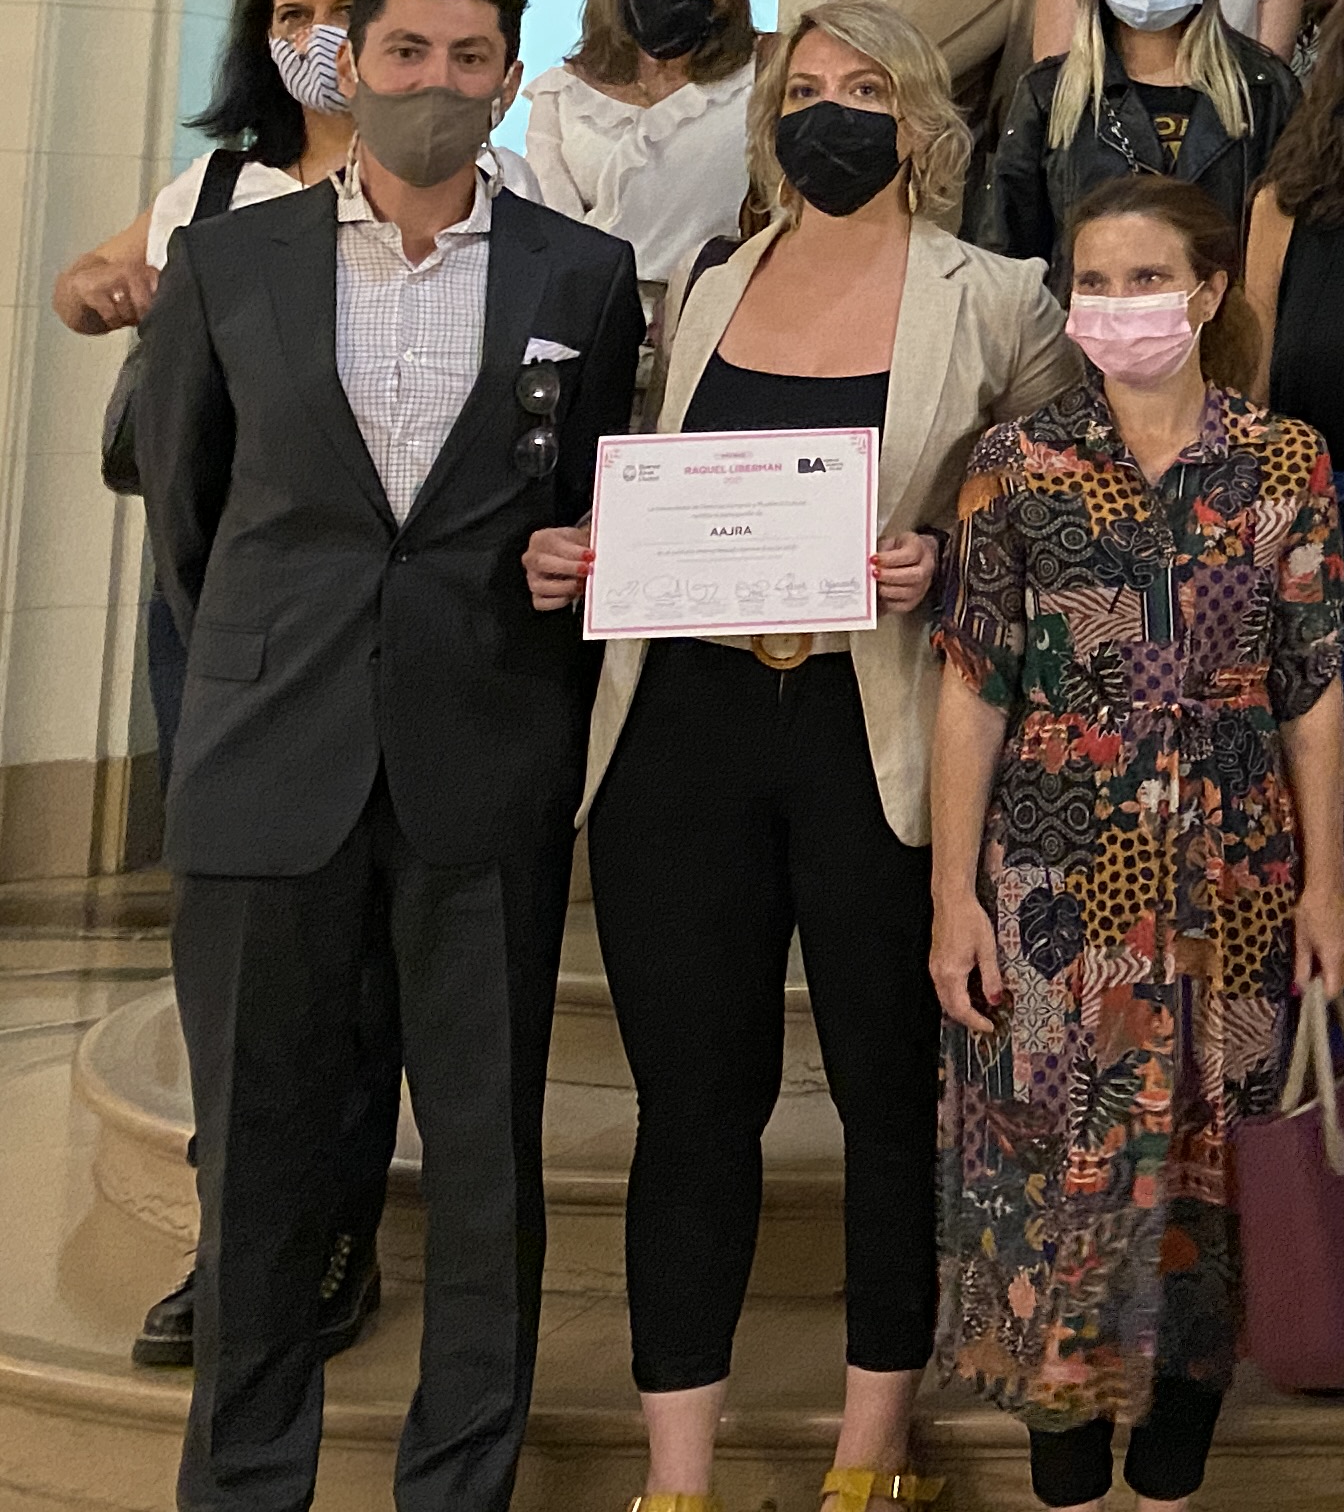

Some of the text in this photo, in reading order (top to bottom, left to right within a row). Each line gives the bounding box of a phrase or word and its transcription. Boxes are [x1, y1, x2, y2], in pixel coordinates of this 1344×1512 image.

[684, 465, 726, 475] RAQUEL
[798, 457, 826, 473] BA
[710, 526, 752, 537] AAJRA
